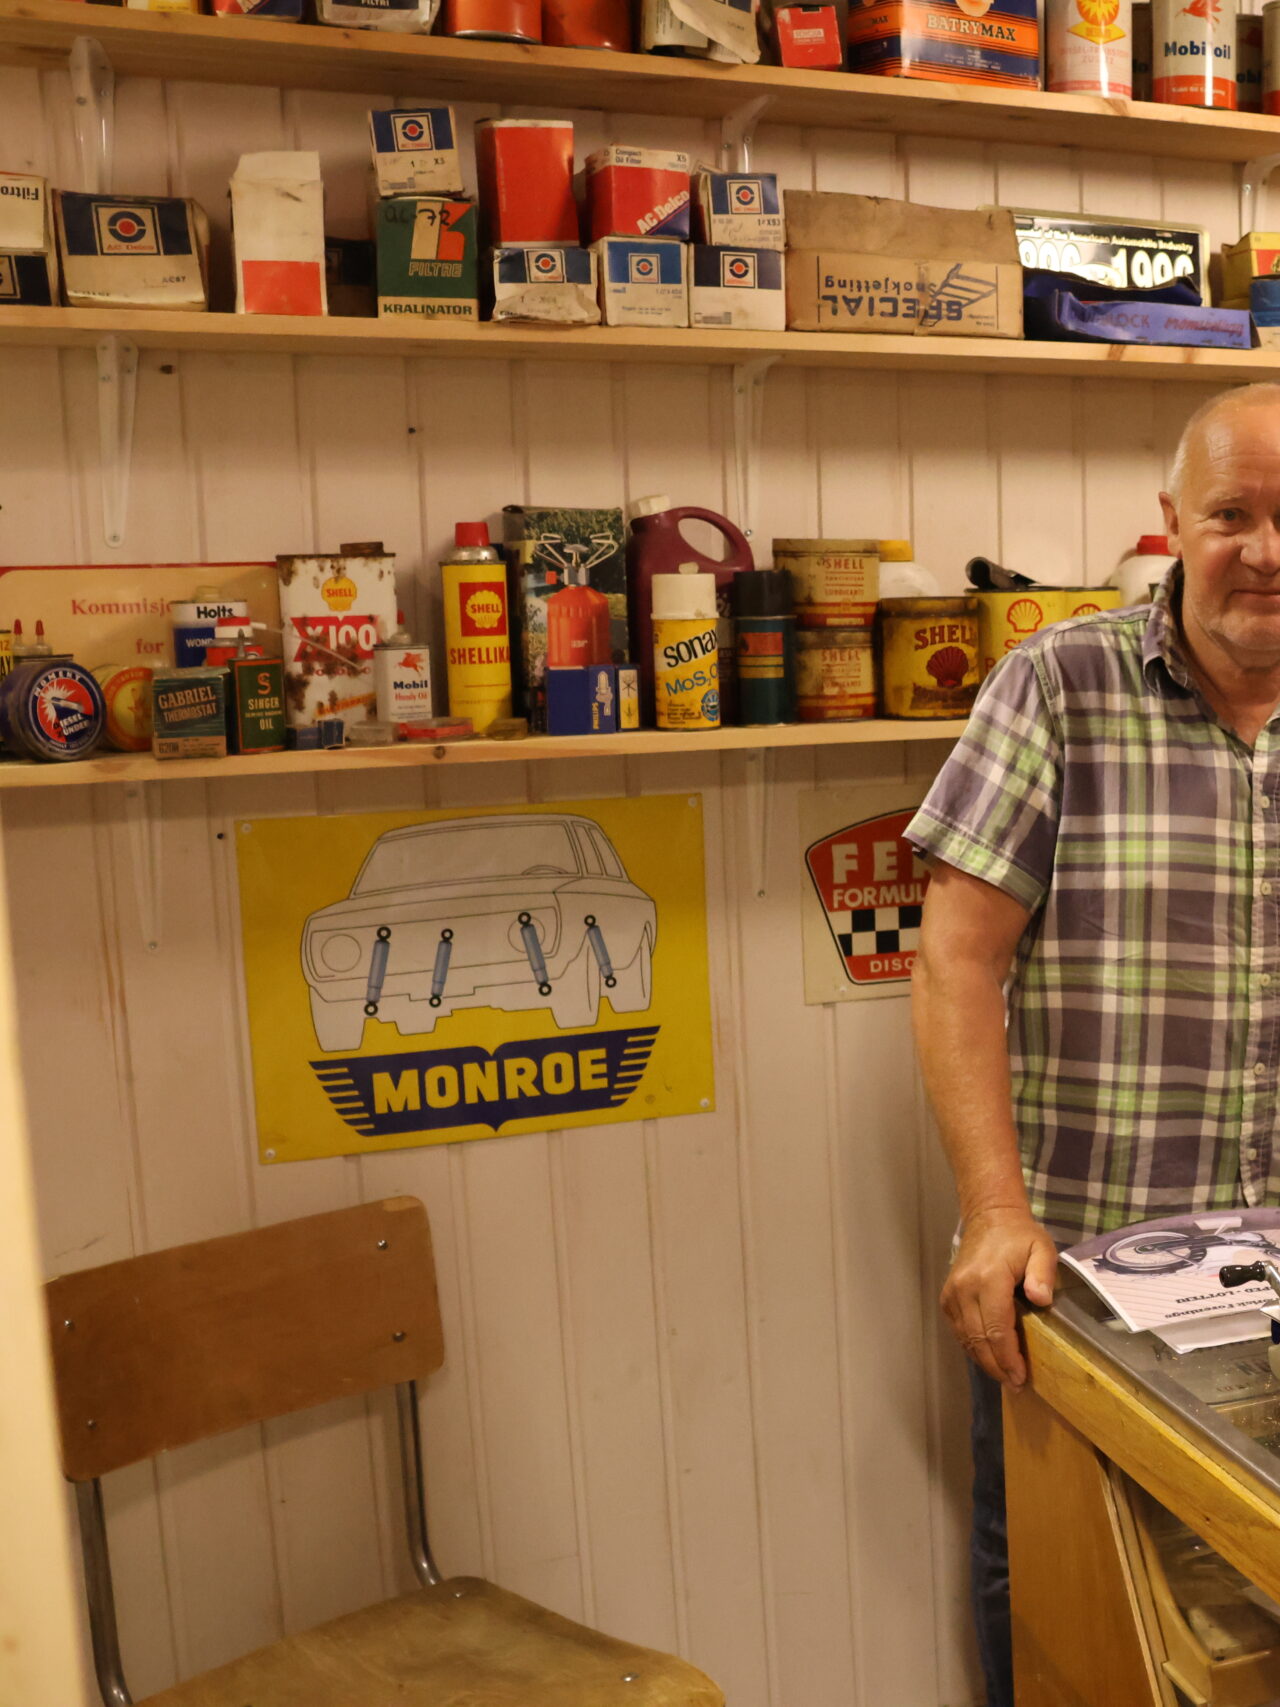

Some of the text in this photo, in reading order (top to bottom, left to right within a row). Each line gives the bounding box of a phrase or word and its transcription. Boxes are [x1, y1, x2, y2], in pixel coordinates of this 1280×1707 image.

[926, 13, 1017, 42] BATRYMAX
[1164, 40, 1231, 60] Mobioil
[636, 189, 691, 235] AC Delco
[408, 261, 463, 278] FILTRE
[383, 303, 473, 316] KRALINATOR
[821, 294, 963, 321] SPECIAL
[825, 557, 865, 570] SHELL
[325, 587, 354, 599] SHELL
[196, 605, 235, 620] Holts
[470, 603, 501, 614] SHELL
[914, 623, 977, 651] SHELL
[135, 638, 165, 655] for
[393, 679, 429, 691] Mobil
[157, 685, 218, 711] GABRIEL
[248, 696, 281, 711] SINGER
[163, 704, 218, 724] THERMOSTAT
[258, 717, 274, 731] OIL
[832, 883, 927, 909] FORMUL
[371, 1047, 610, 1116] MONROE
[1175, 1289, 1235, 1304] LOTTERI
